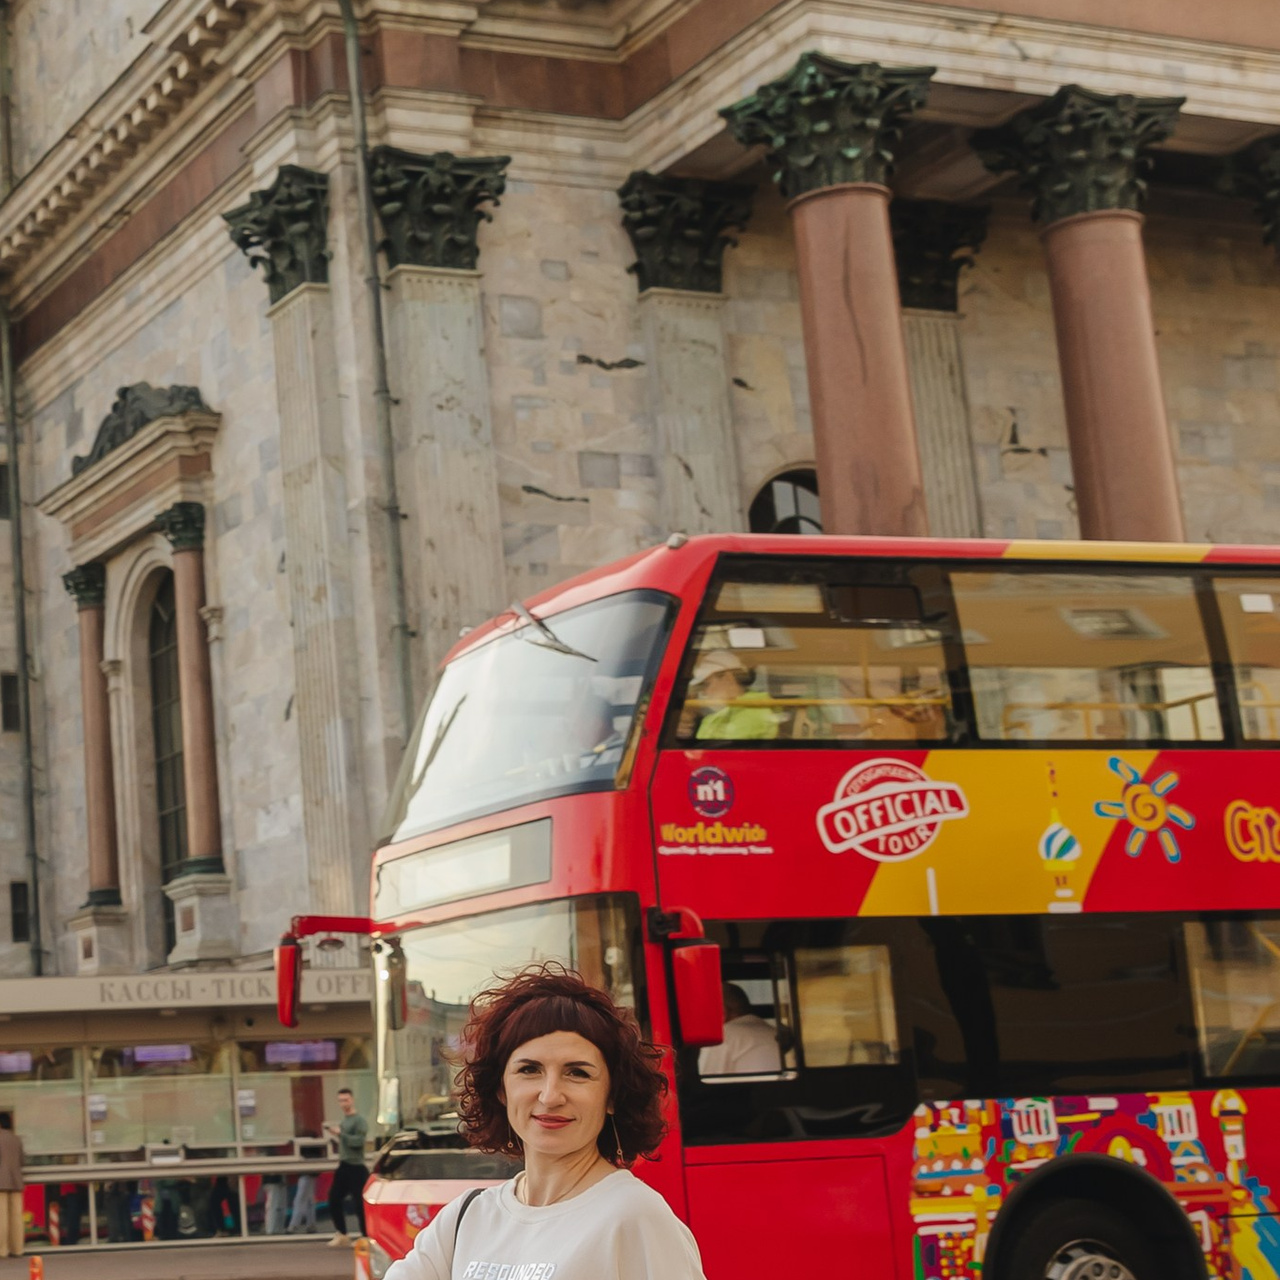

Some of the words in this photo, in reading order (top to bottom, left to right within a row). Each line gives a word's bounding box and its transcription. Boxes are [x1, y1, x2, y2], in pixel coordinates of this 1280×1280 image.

[834, 789, 960, 840] OFFICIAL
[877, 824, 933, 854] TOUR
[99, 979, 192, 1003] КАССЫ
[210, 976, 273, 1000] TICK
